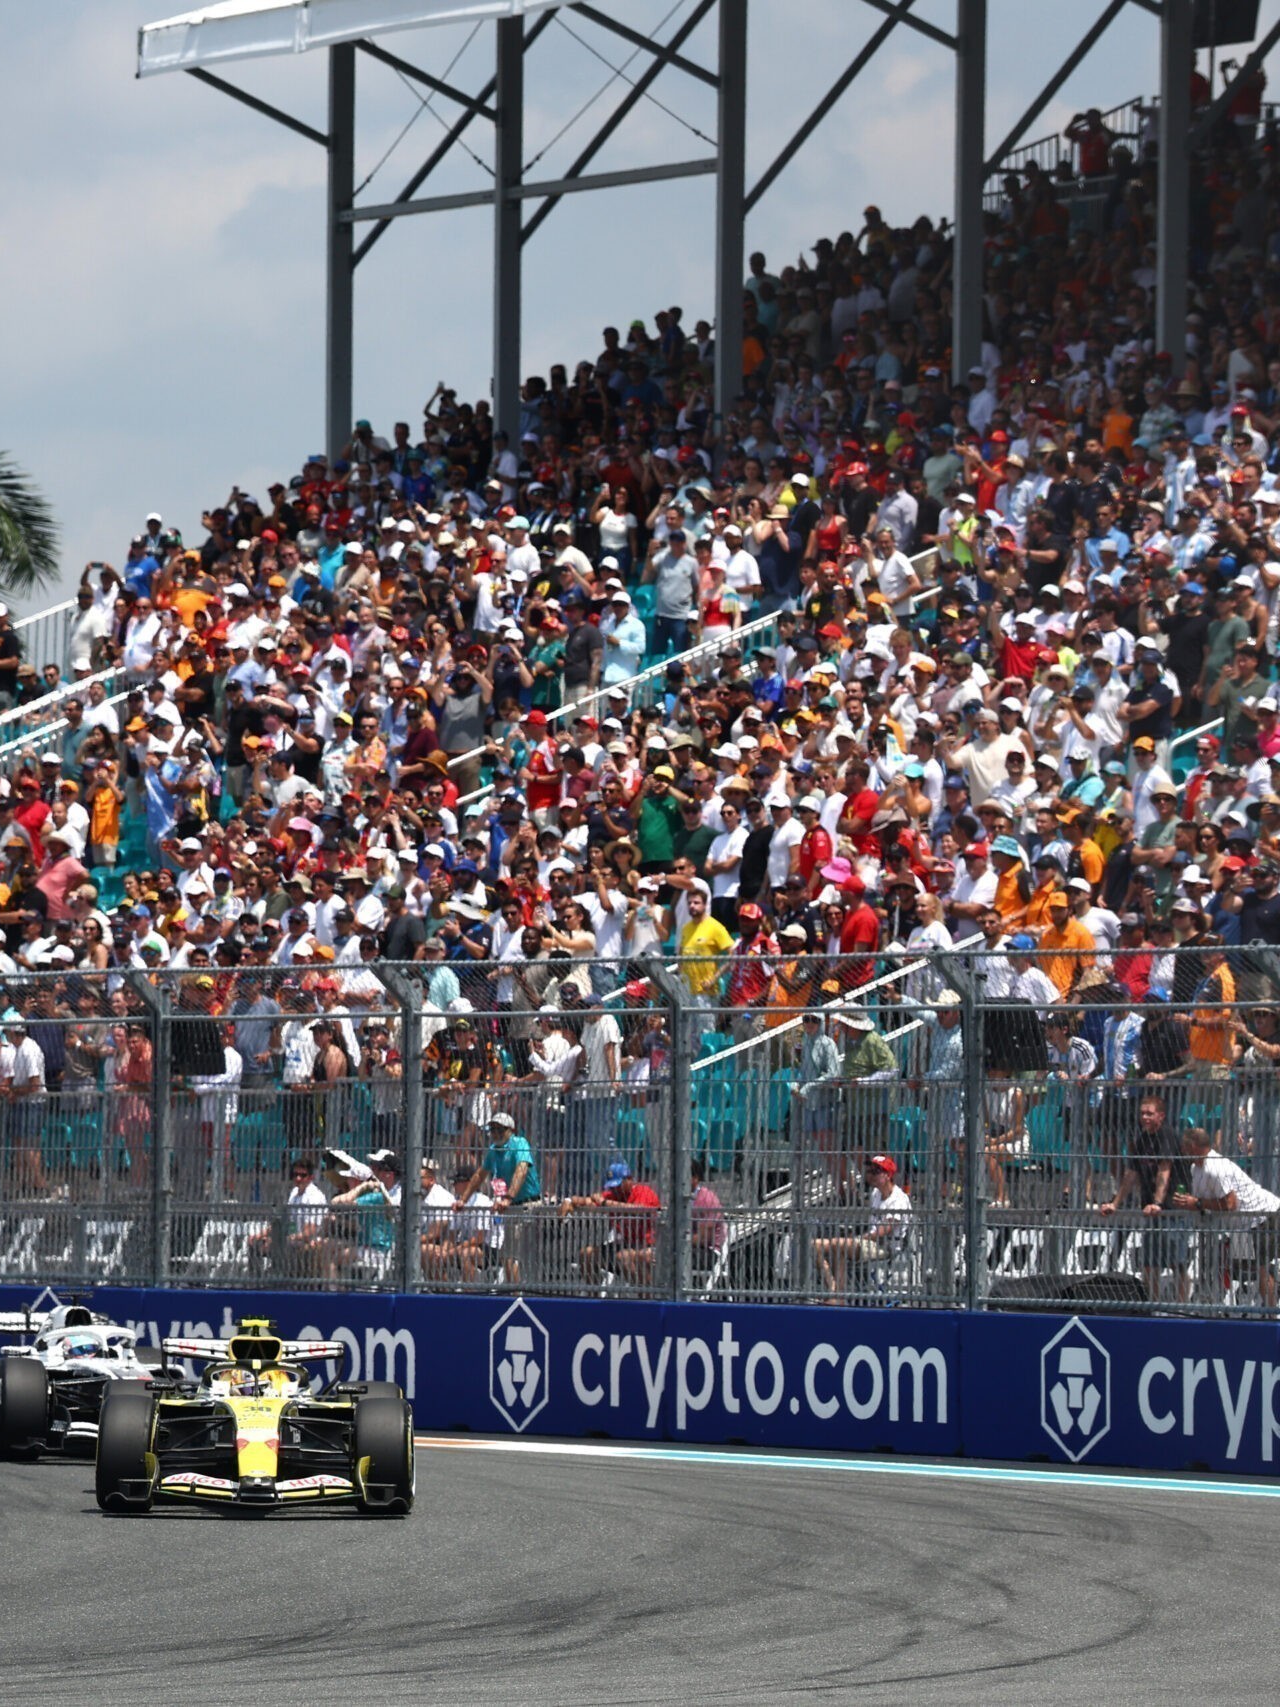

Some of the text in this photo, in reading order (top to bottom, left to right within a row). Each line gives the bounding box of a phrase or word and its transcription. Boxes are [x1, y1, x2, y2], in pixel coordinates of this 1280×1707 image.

[573, 1321, 947, 1430] crypto.com
[171, 1474, 226, 1486] HUGO
[289, 1476, 347, 1488] HUGO
